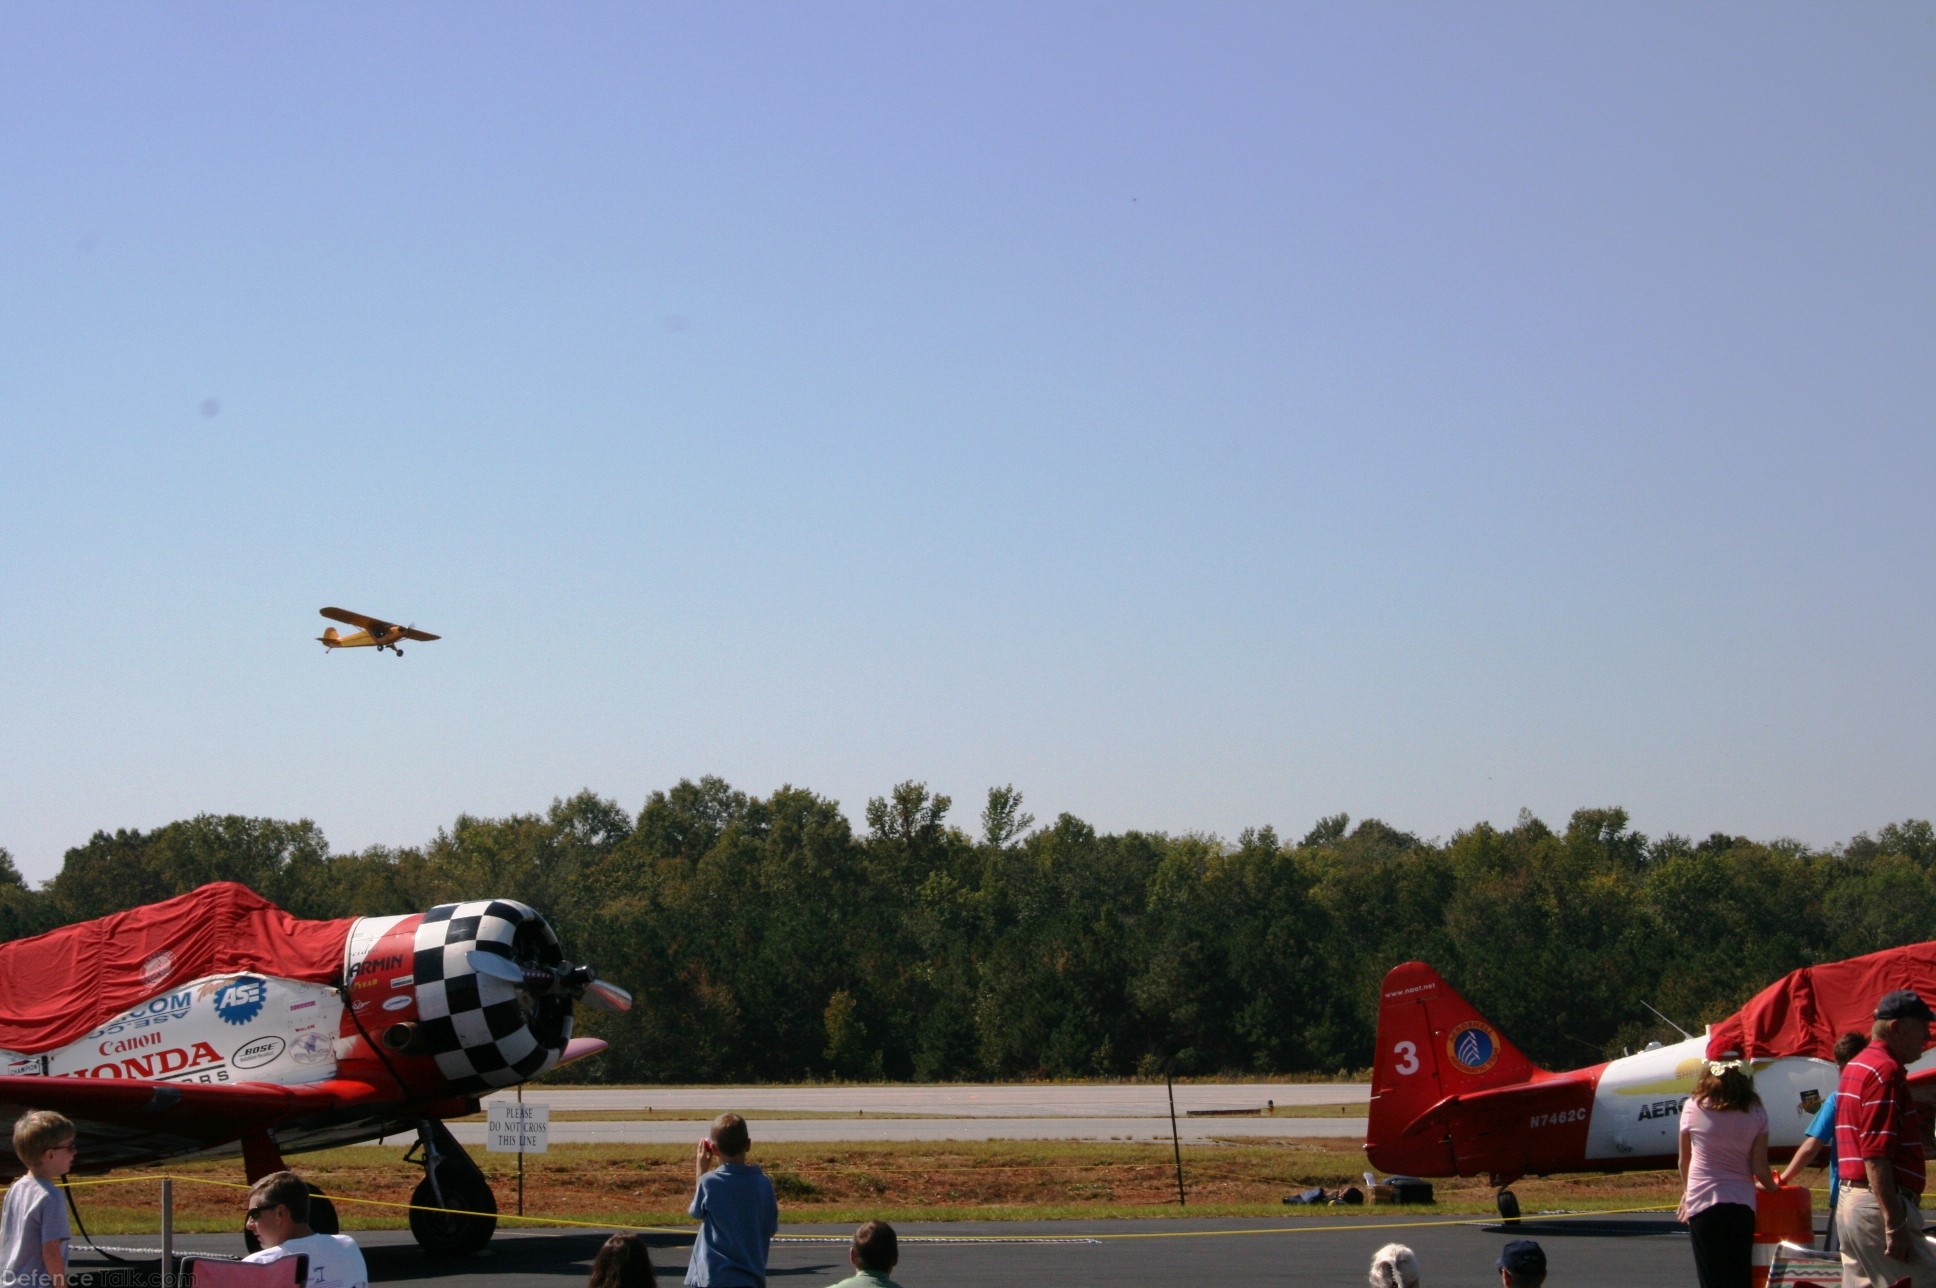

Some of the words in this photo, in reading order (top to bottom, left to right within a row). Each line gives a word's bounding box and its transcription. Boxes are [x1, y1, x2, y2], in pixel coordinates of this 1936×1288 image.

[219, 982, 260, 1009] ASE
[98, 1031, 161, 1056] Canon
[244, 1042, 279, 1056] BOSE
[1394, 1041, 1419, 1075] 3
[506, 1107, 533, 1119] PLEASE
[1530, 1108, 1586, 1128] N7462C
[489, 1120, 501, 1132] DO
[504, 1121, 521, 1132] NOT
[523, 1122, 548, 1133] CROSS
[498, 1135, 516, 1146] THIS
[519, 1135, 537, 1147] LINE
